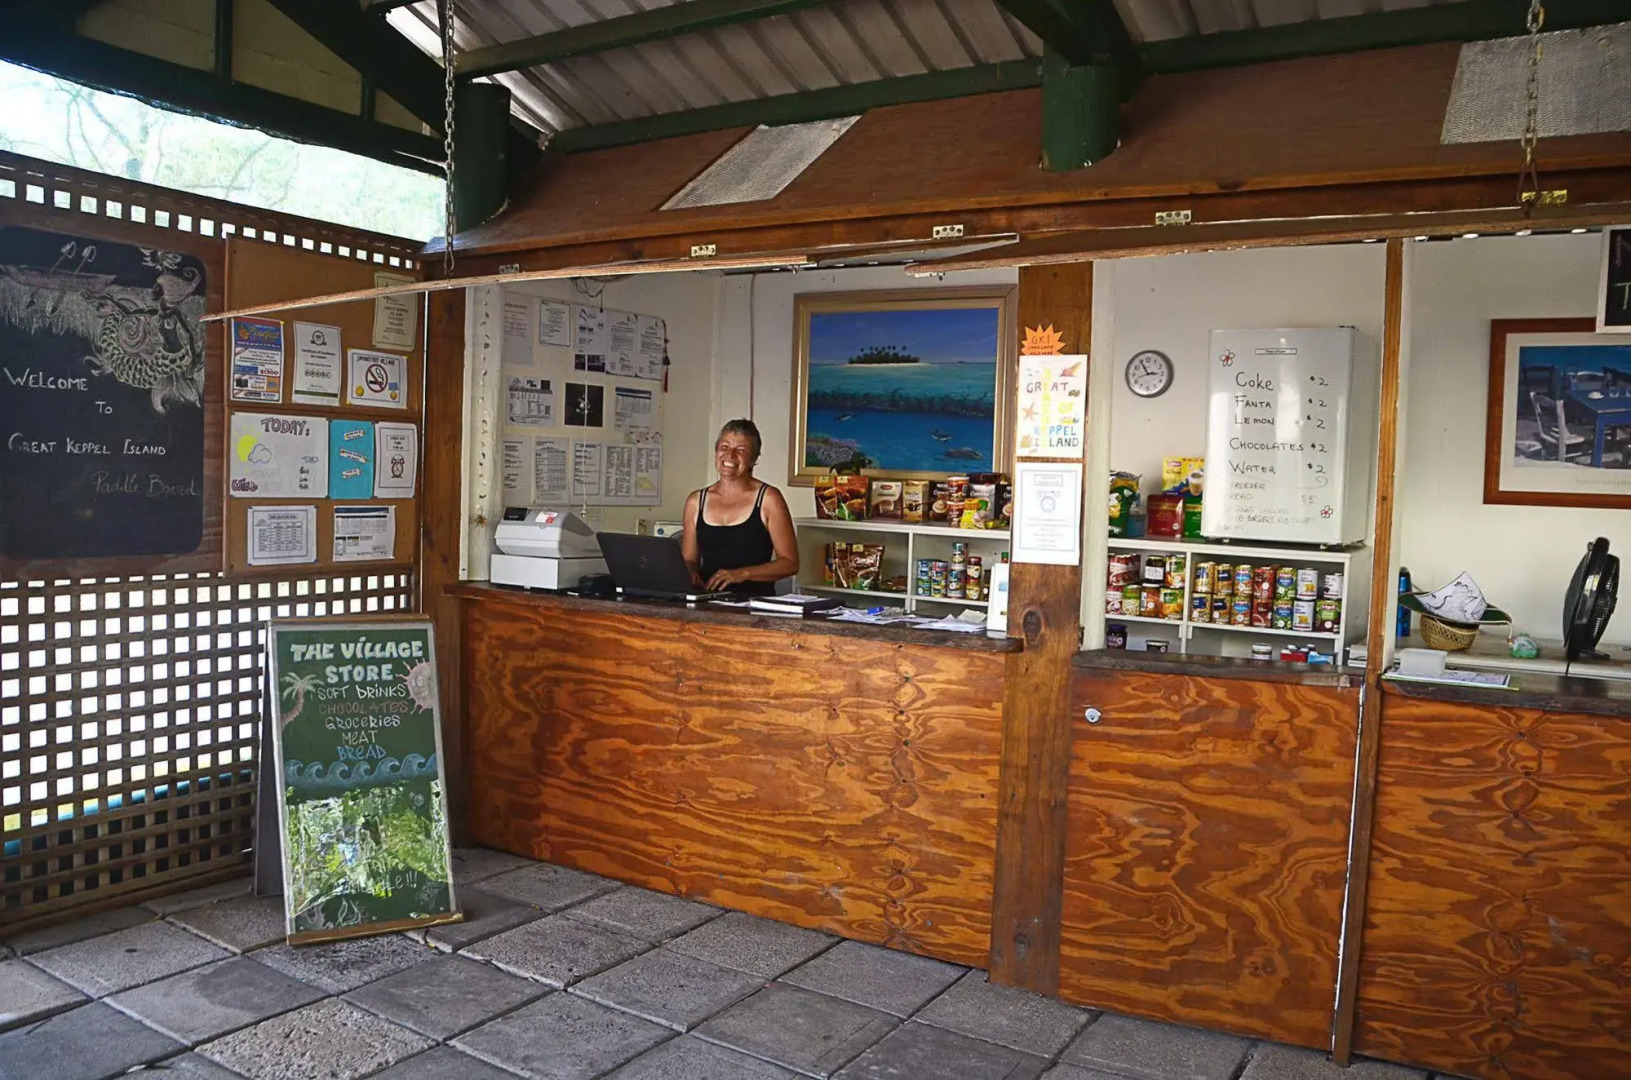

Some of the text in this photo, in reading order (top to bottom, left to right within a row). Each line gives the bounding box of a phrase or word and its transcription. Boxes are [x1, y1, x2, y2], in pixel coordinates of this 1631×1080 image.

[1031, 335, 1051, 345] GKI
[4, 367, 88, 391] WELCOME
[1235, 371, 1274, 391] Coke
[1234, 394, 1272, 409] FANTA
[1234, 414, 1275, 426] LEMON
[8, 432, 166, 455] GREAT KEPPEL ISLAND
[1229, 437, 1305, 452] CHOCOLATES
[1229, 460, 1276, 474] WATER
[290, 637, 424, 662] THE VILLAGE
[325, 663, 394, 684] STORE
[317, 685, 350, 701] SOFT
